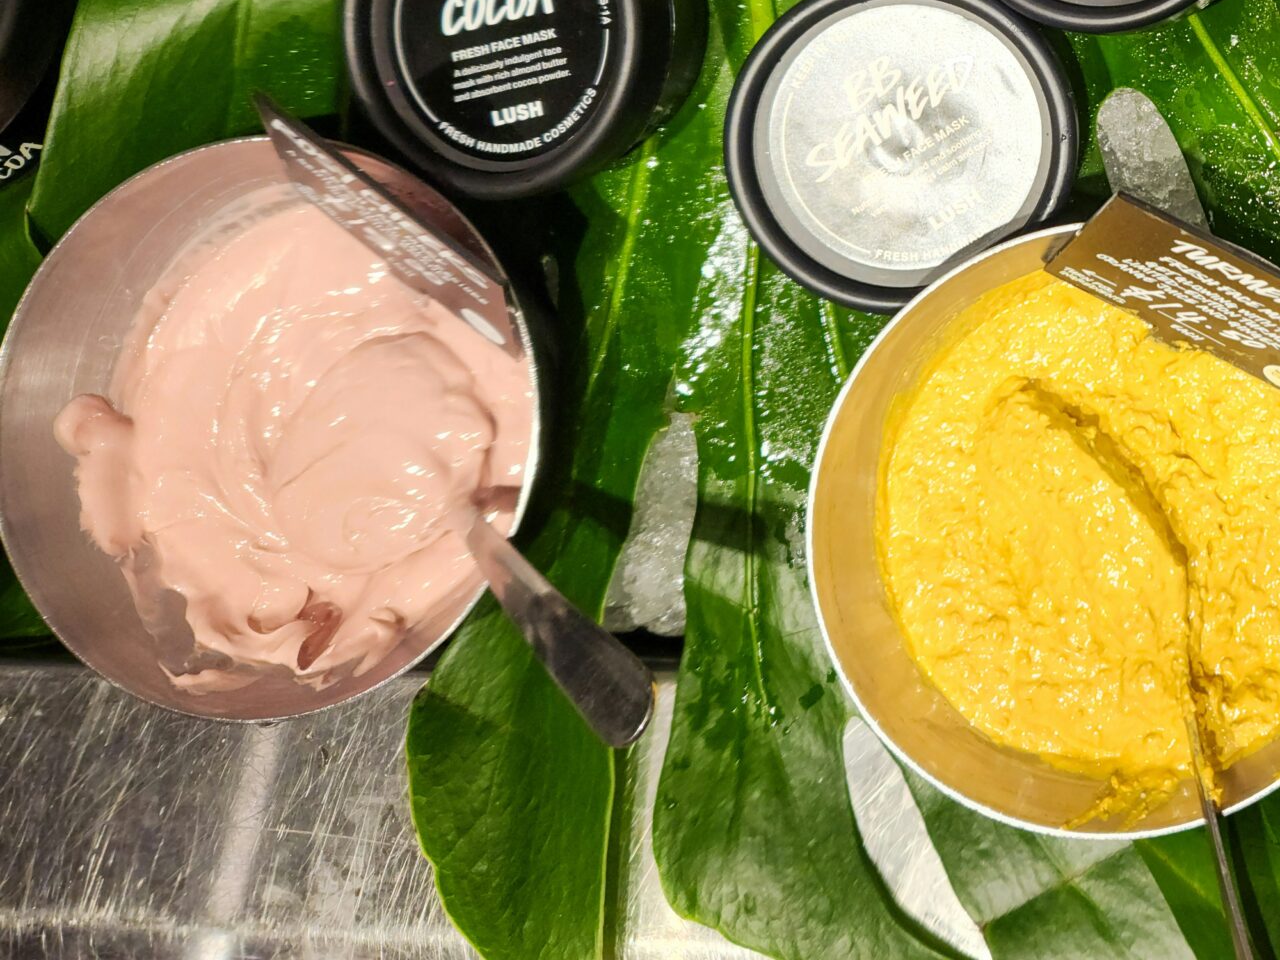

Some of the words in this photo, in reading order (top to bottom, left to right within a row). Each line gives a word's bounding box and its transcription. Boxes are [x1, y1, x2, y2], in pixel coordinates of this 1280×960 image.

[452, 45, 489, 62] FRESH
[490, 37, 521, 53] FACE
[520, 28, 557, 46] MASK
[438, 122, 475, 148] FRESH
[477, 138, 542, 153] HANDMADE
[543, 87, 597, 143] COSMETICS
[491, 100, 543, 126] LUSH
[806, 55, 973, 183] SEAWEED
[903, 139, 934, 162] FACE
[935, 115, 970, 142] MASK
